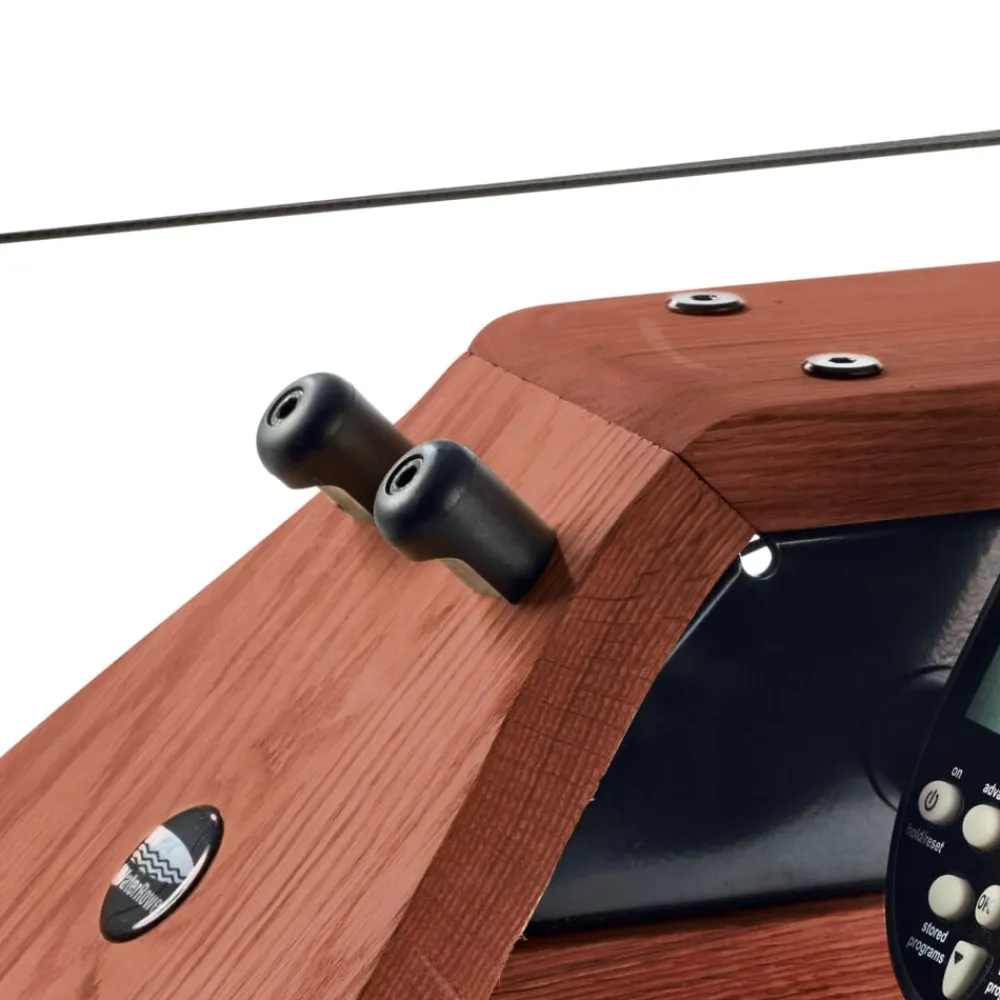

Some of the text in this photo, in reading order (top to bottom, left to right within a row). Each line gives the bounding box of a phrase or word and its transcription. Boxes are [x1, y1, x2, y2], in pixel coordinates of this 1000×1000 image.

[951, 766, 963, 779] on
[905, 824, 945, 854] hold/reset
[115, 866, 164, 914] aterRowe
[977, 894, 990, 914] OK
[921, 921, 949, 943] stored
[907, 935, 945, 964] programs
